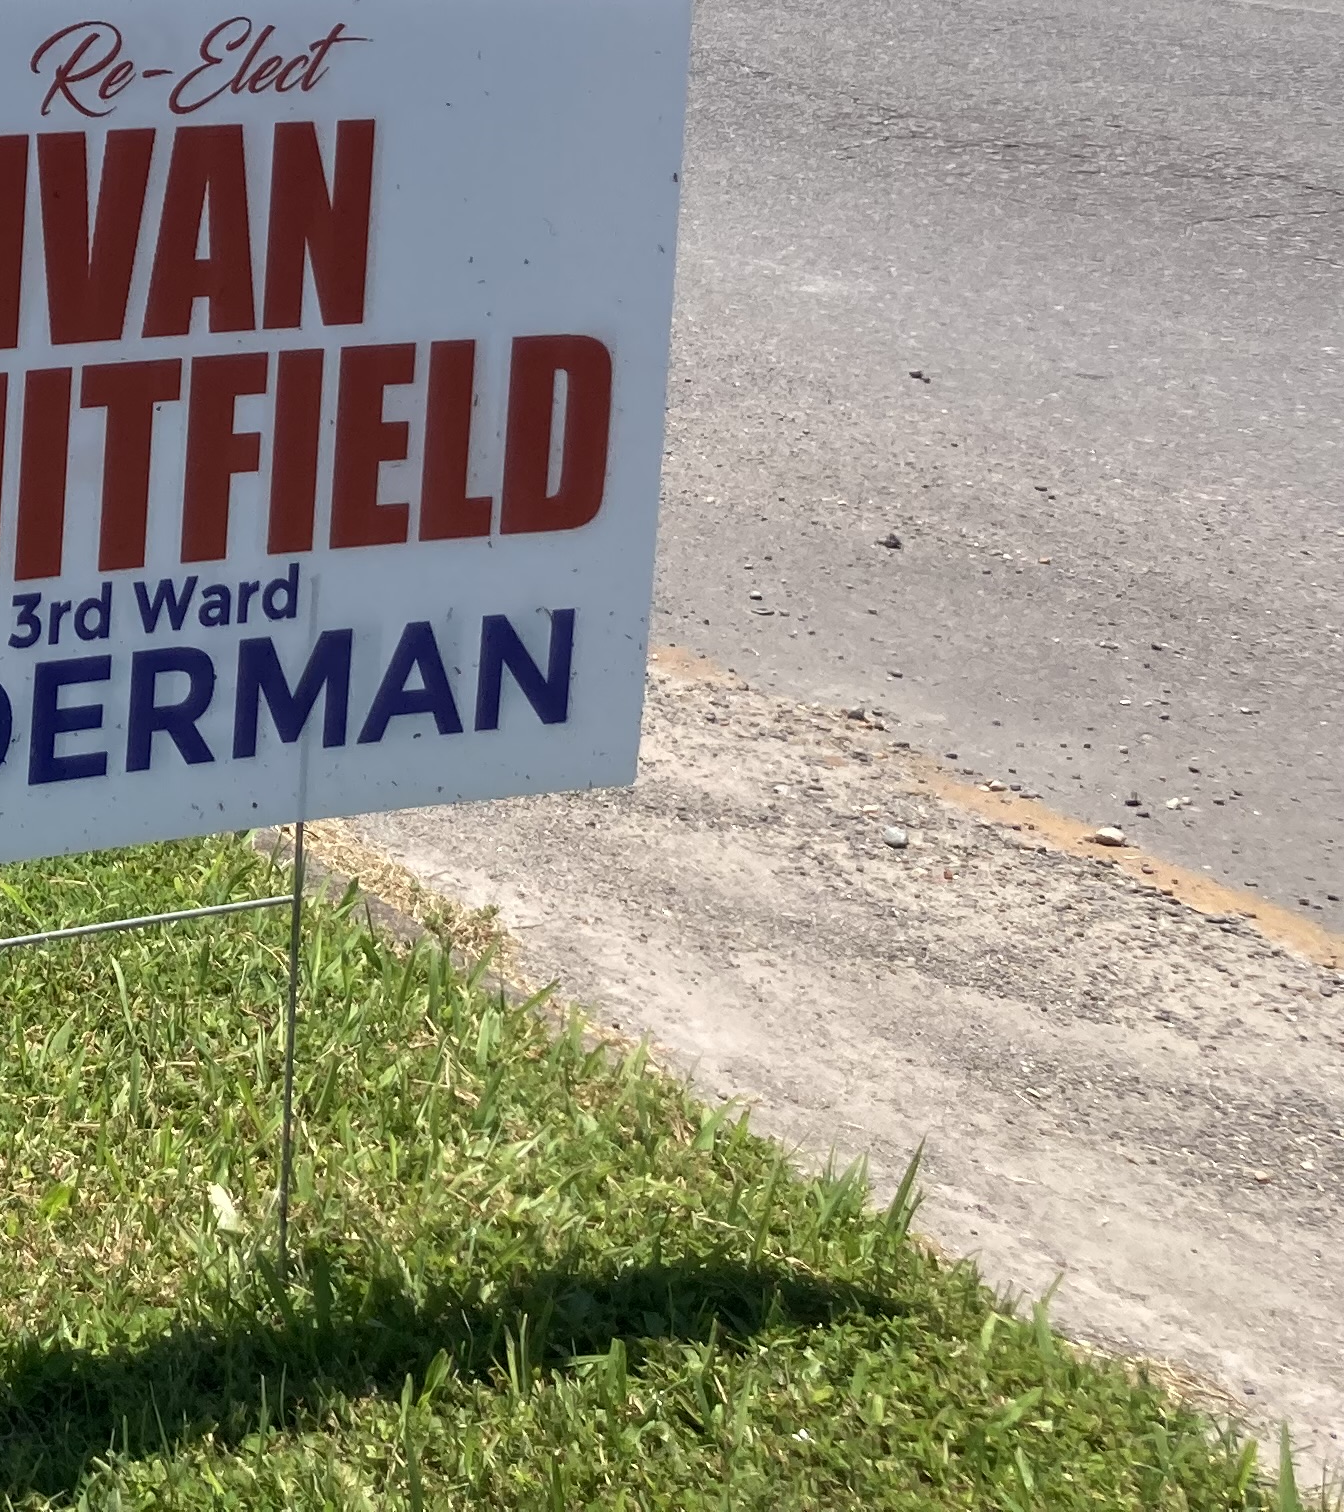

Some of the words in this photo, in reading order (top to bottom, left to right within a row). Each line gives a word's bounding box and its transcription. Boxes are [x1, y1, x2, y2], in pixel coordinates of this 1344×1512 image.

[30, 15, 374, 118] Re-Elect
[7, 581, 113, 650] 3rd
[133, 561, 300, 634] Ward
